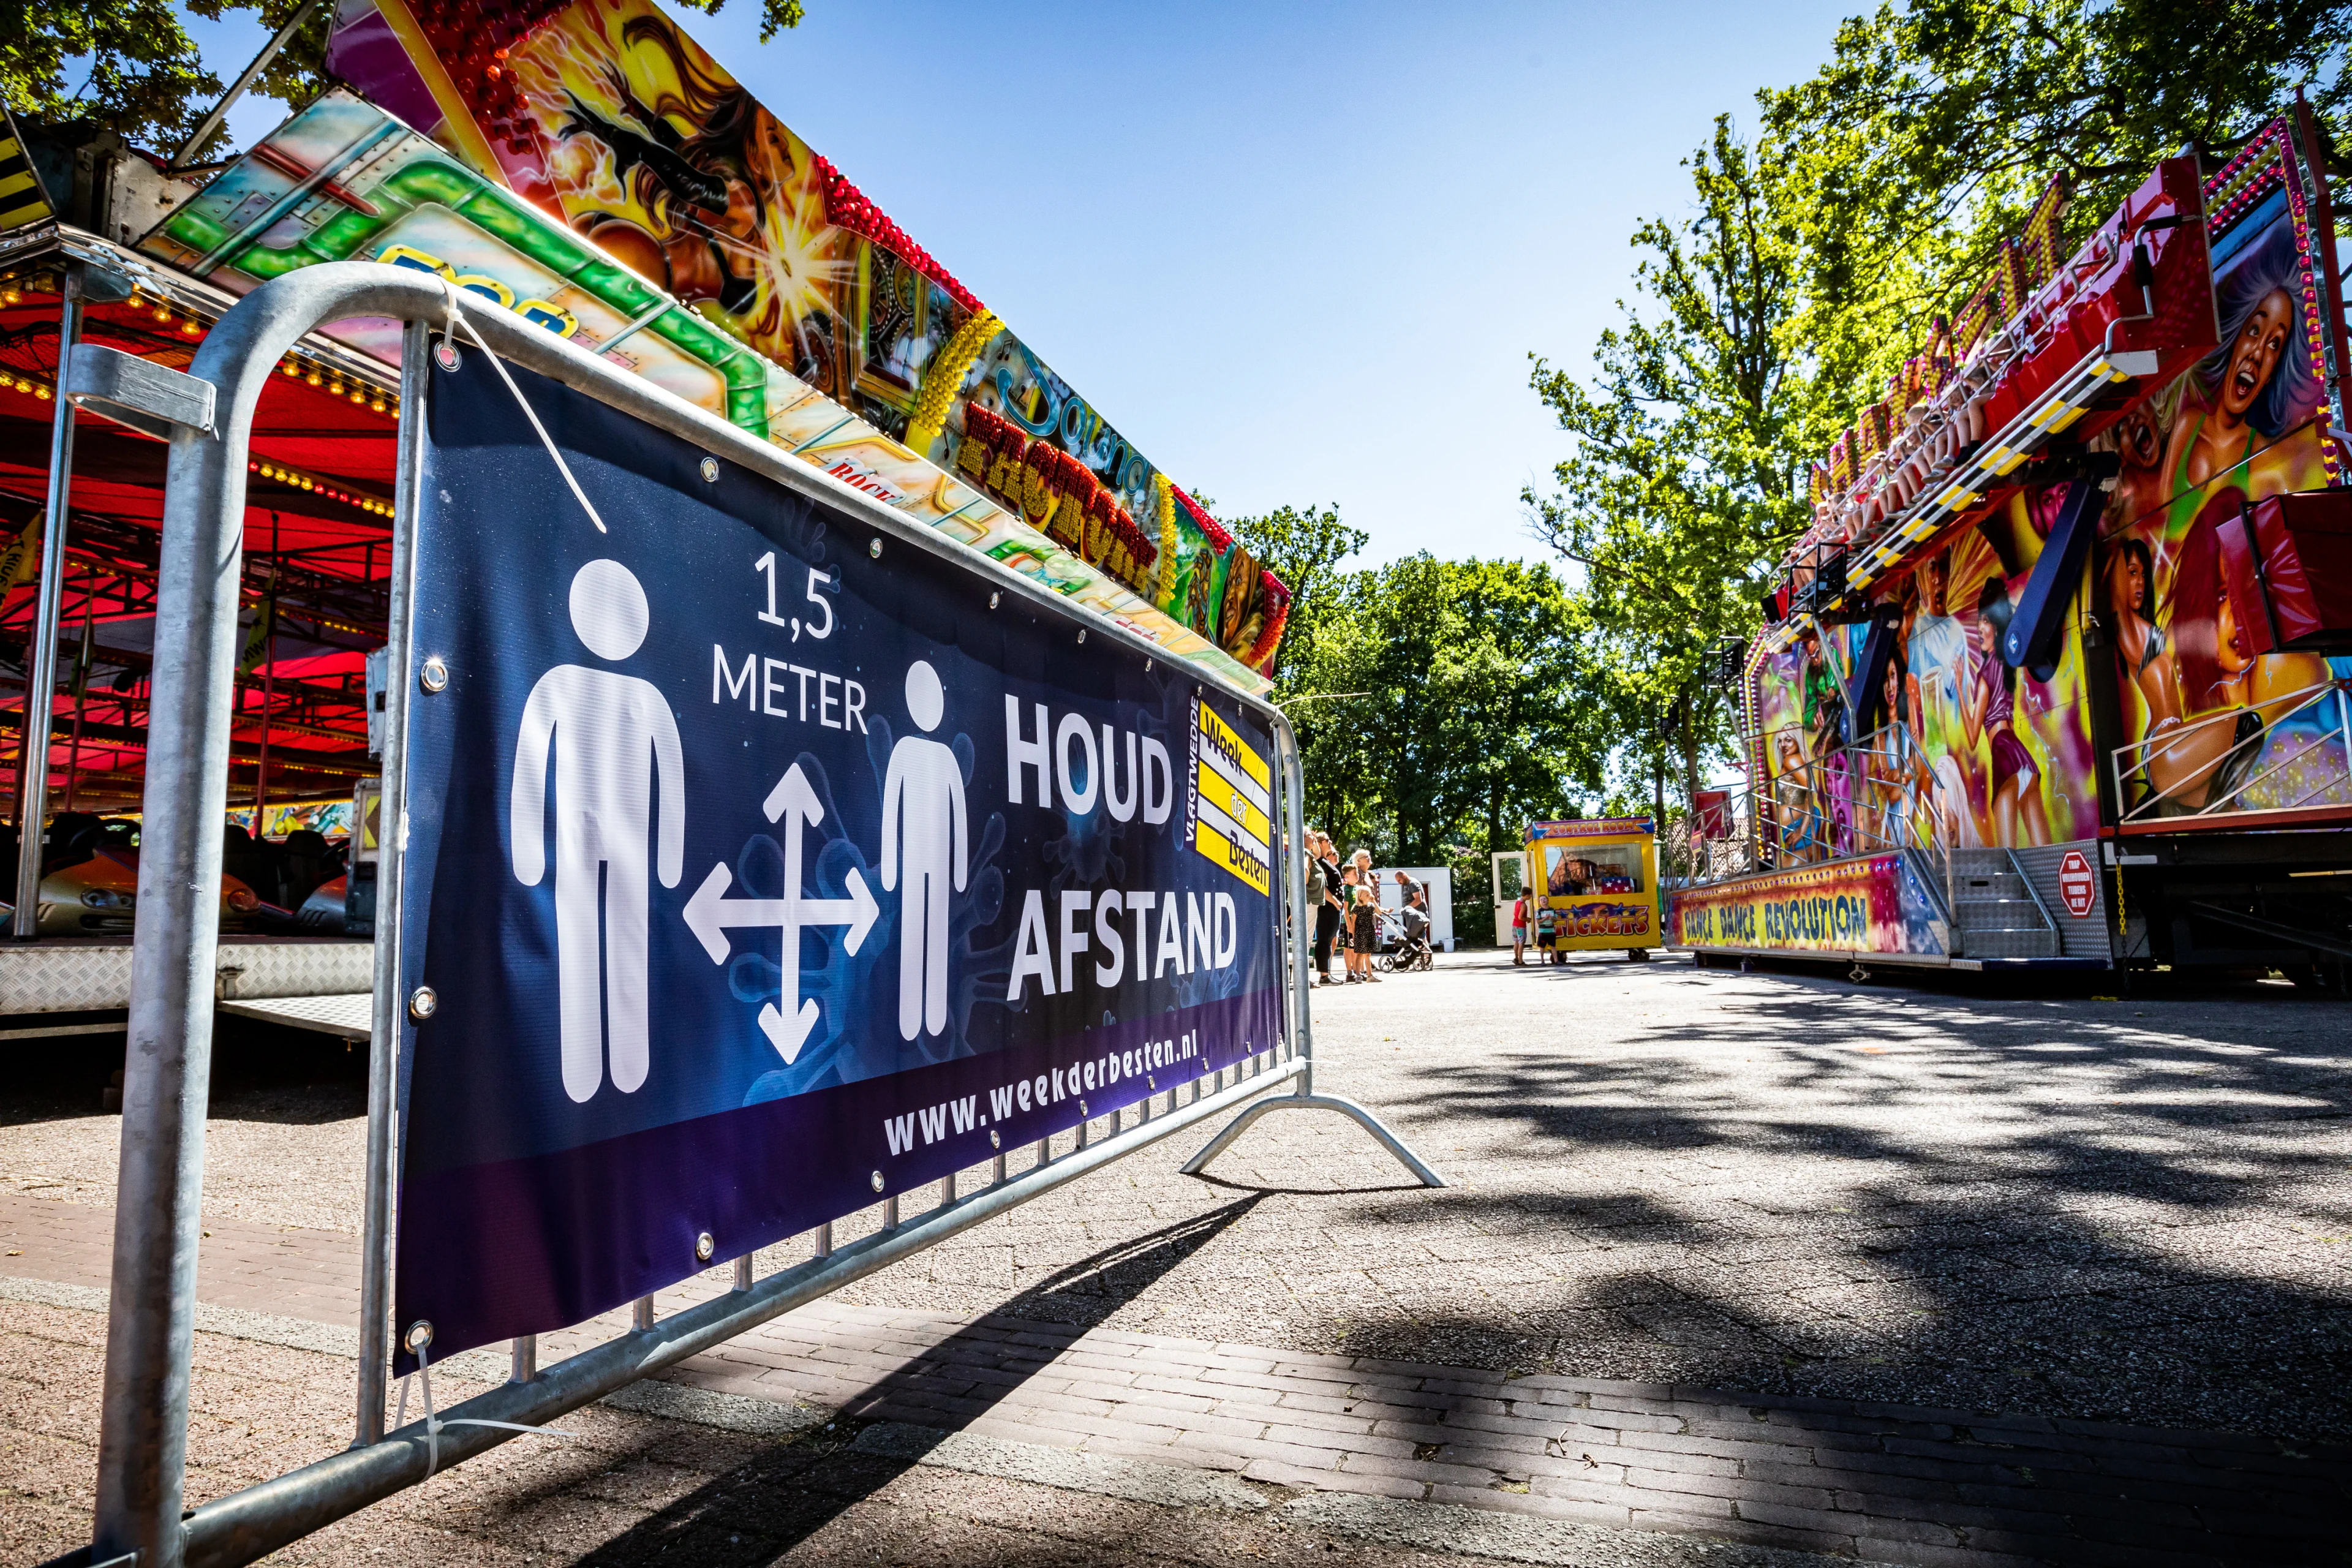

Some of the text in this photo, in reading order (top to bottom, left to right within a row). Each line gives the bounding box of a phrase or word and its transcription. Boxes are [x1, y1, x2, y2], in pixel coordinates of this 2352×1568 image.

[997, 342, 1150, 496] Sound
[755, 551, 833, 643] 1,5
[713, 643, 869, 735] METER
[1005, 693, 1173, 826] HOUD
[1186, 696, 1199, 842] VLAGTWEDDE
[1205, 710, 1243, 777] Week
[1231, 790, 1247, 825] der
[1553, 821, 1635, 835] CONTROL ROOM
[1229, 829, 1267, 888] Besten
[2068, 860, 2080, 869] TRAP
[1006, 889, 1237, 1001] AFSTAND
[1555, 914, 1649, 938] TICKETS
[1684, 894, 1867, 944] DANCE DANCE REVOLUTION
[884, 1028, 1198, 1156] www.weekderbesten.nl
